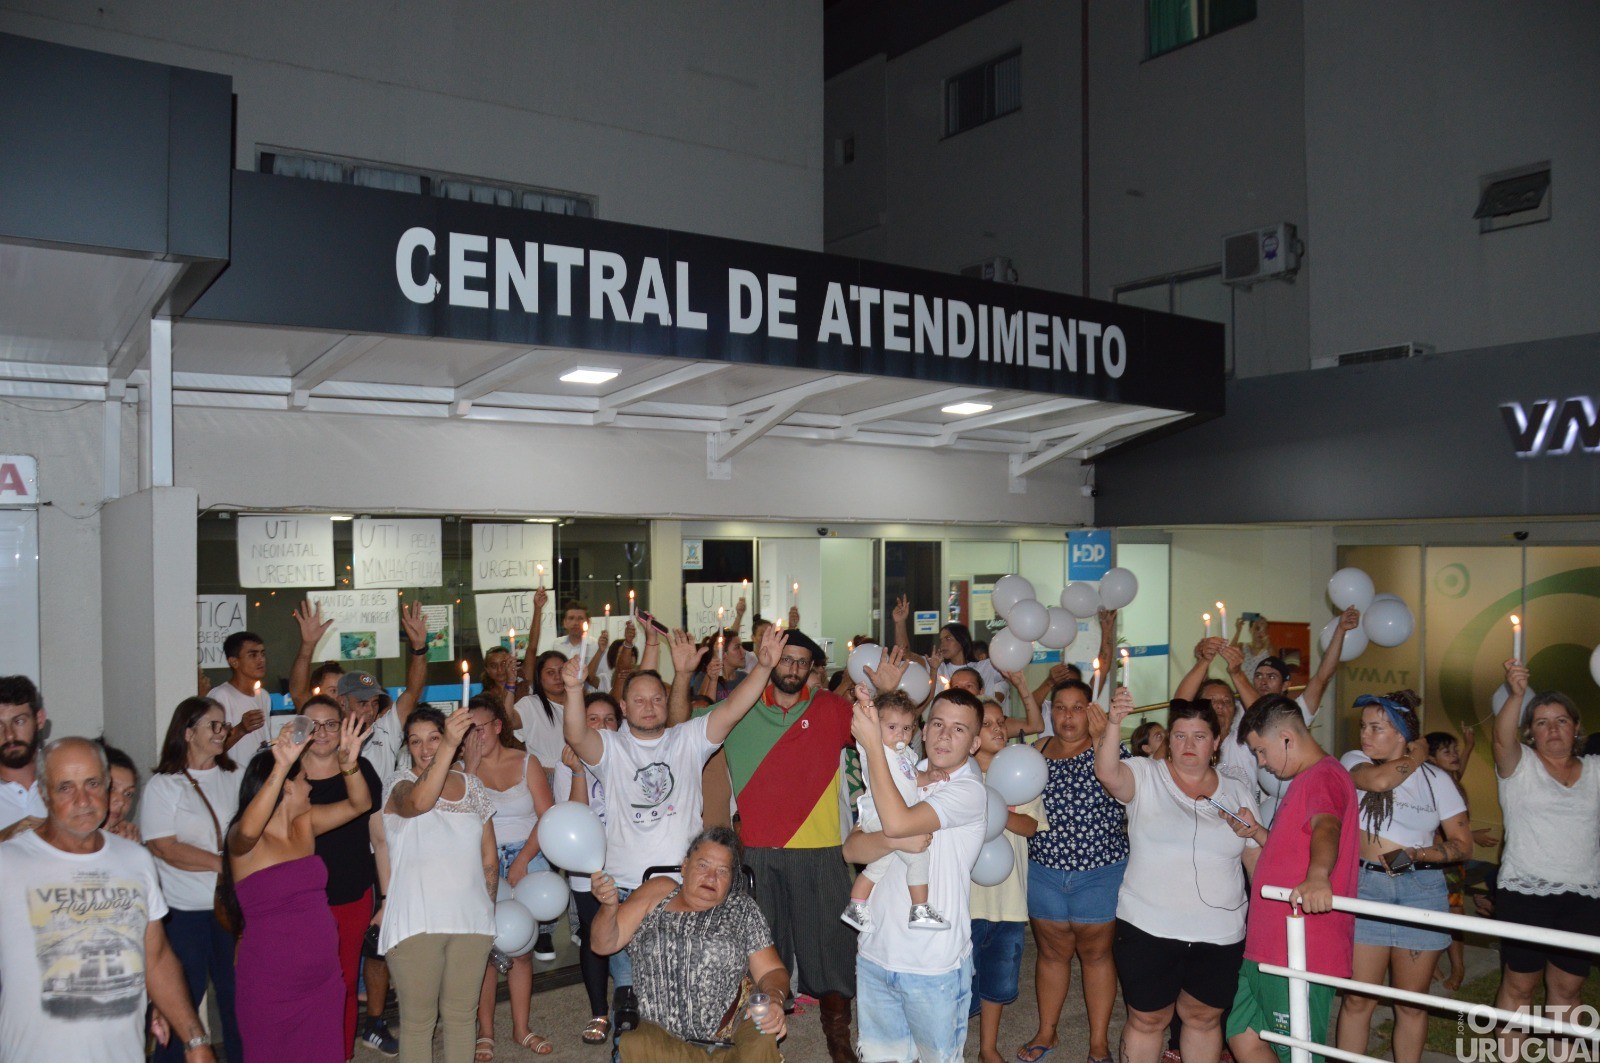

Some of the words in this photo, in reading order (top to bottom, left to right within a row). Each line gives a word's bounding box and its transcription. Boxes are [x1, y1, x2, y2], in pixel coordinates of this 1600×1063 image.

[396, 227, 708, 331] CENTRAL
[728, 268, 798, 340] DE
[817, 281, 1127, 379] ATENDIMENTO
[265, 520, 299, 539] UTI
[360, 523, 400, 549] UTI
[411, 533, 437, 548] PELA
[482, 525, 524, 553] UTI
[251, 543, 319, 559] NEONATAL
[1072, 544, 1106, 563] HDP
[257, 563, 326, 584] URGENTE
[480, 559, 549, 579] URGENTE
[501, 591, 529, 614] ATÉ
[702, 584, 733, 609] UTI
[487, 616, 532, 634] QUANDO
[36, 887, 142, 902] VENTURA
[51, 898, 133, 915] Highway
